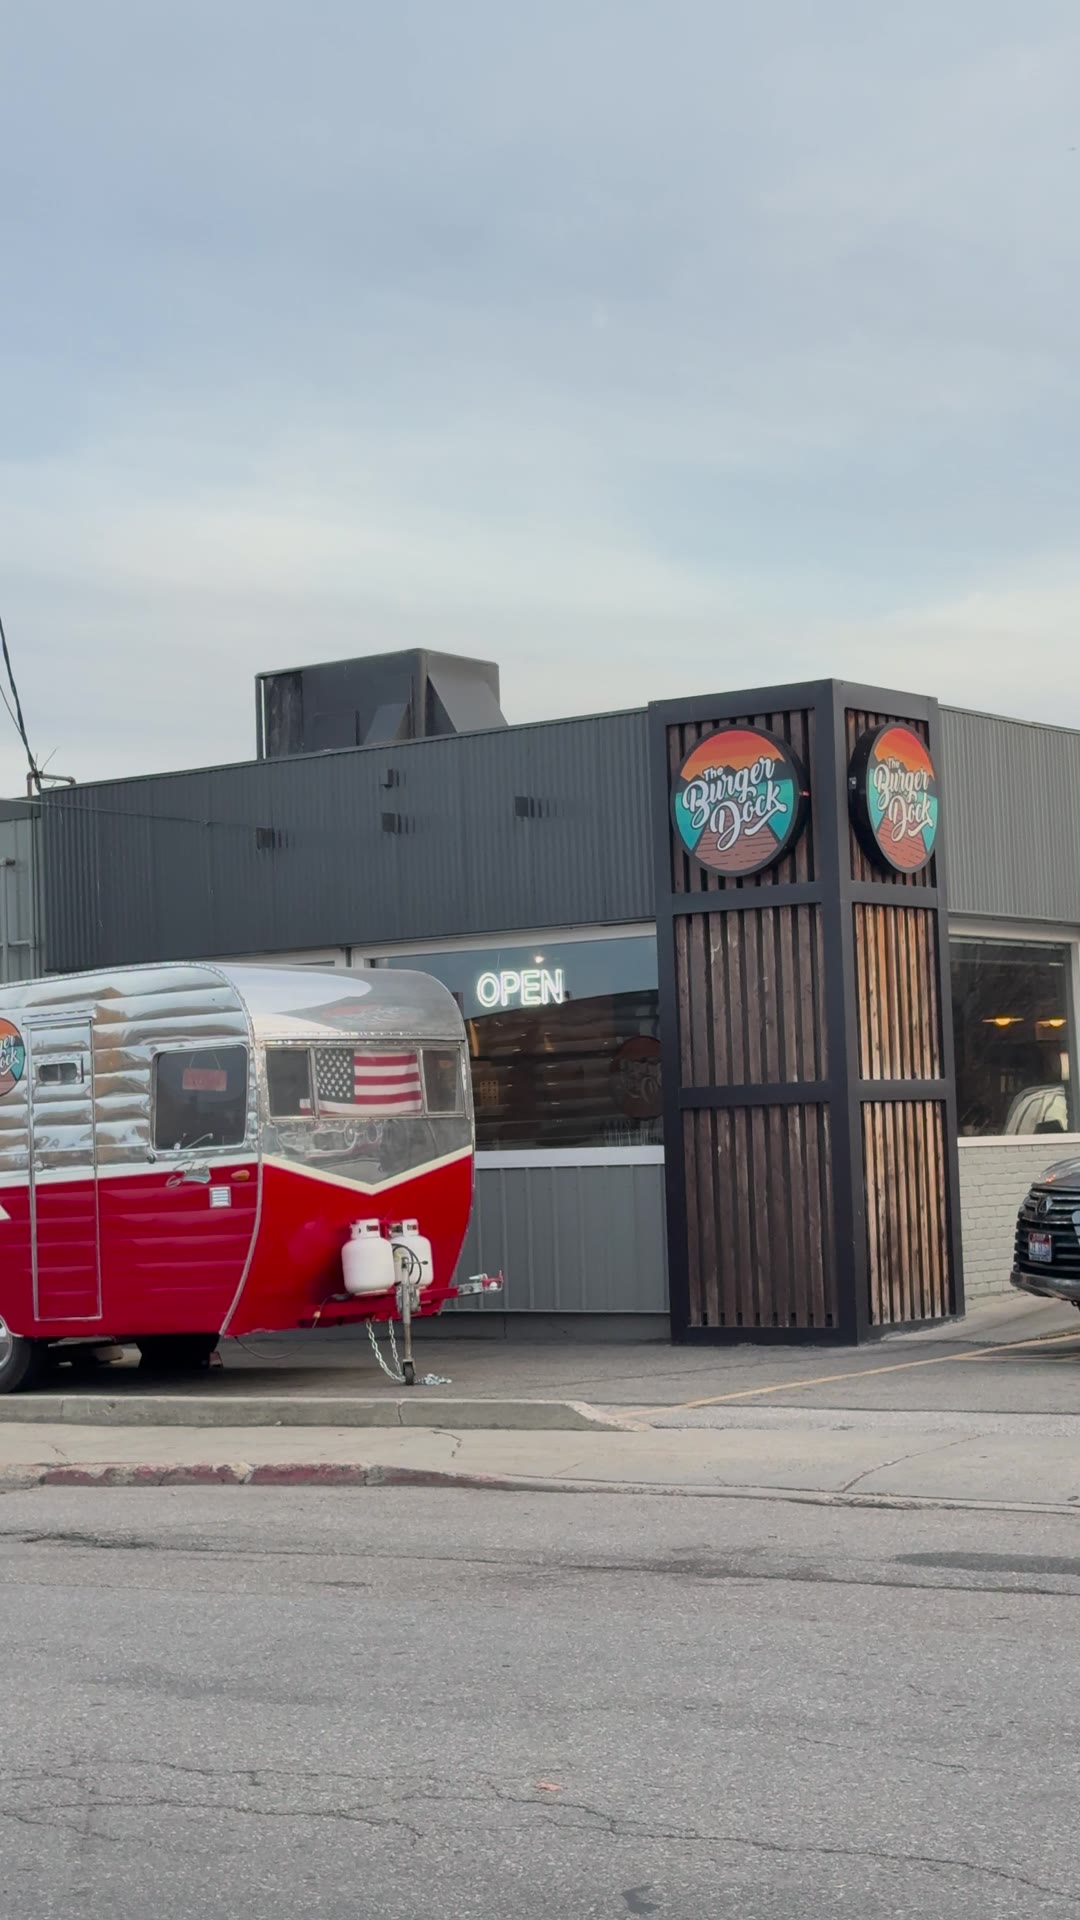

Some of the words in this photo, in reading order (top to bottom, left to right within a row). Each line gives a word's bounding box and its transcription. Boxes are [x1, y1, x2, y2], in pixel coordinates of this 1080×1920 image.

[704, 766, 724, 782] The
[873, 763, 928, 811] Burger
[887, 758, 900, 769] The
[682, 756, 775, 829] Burger
[710, 780, 788, 851] Dock
[888, 791, 934, 842] Dock
[477, 969, 563, 1008] OPEN
